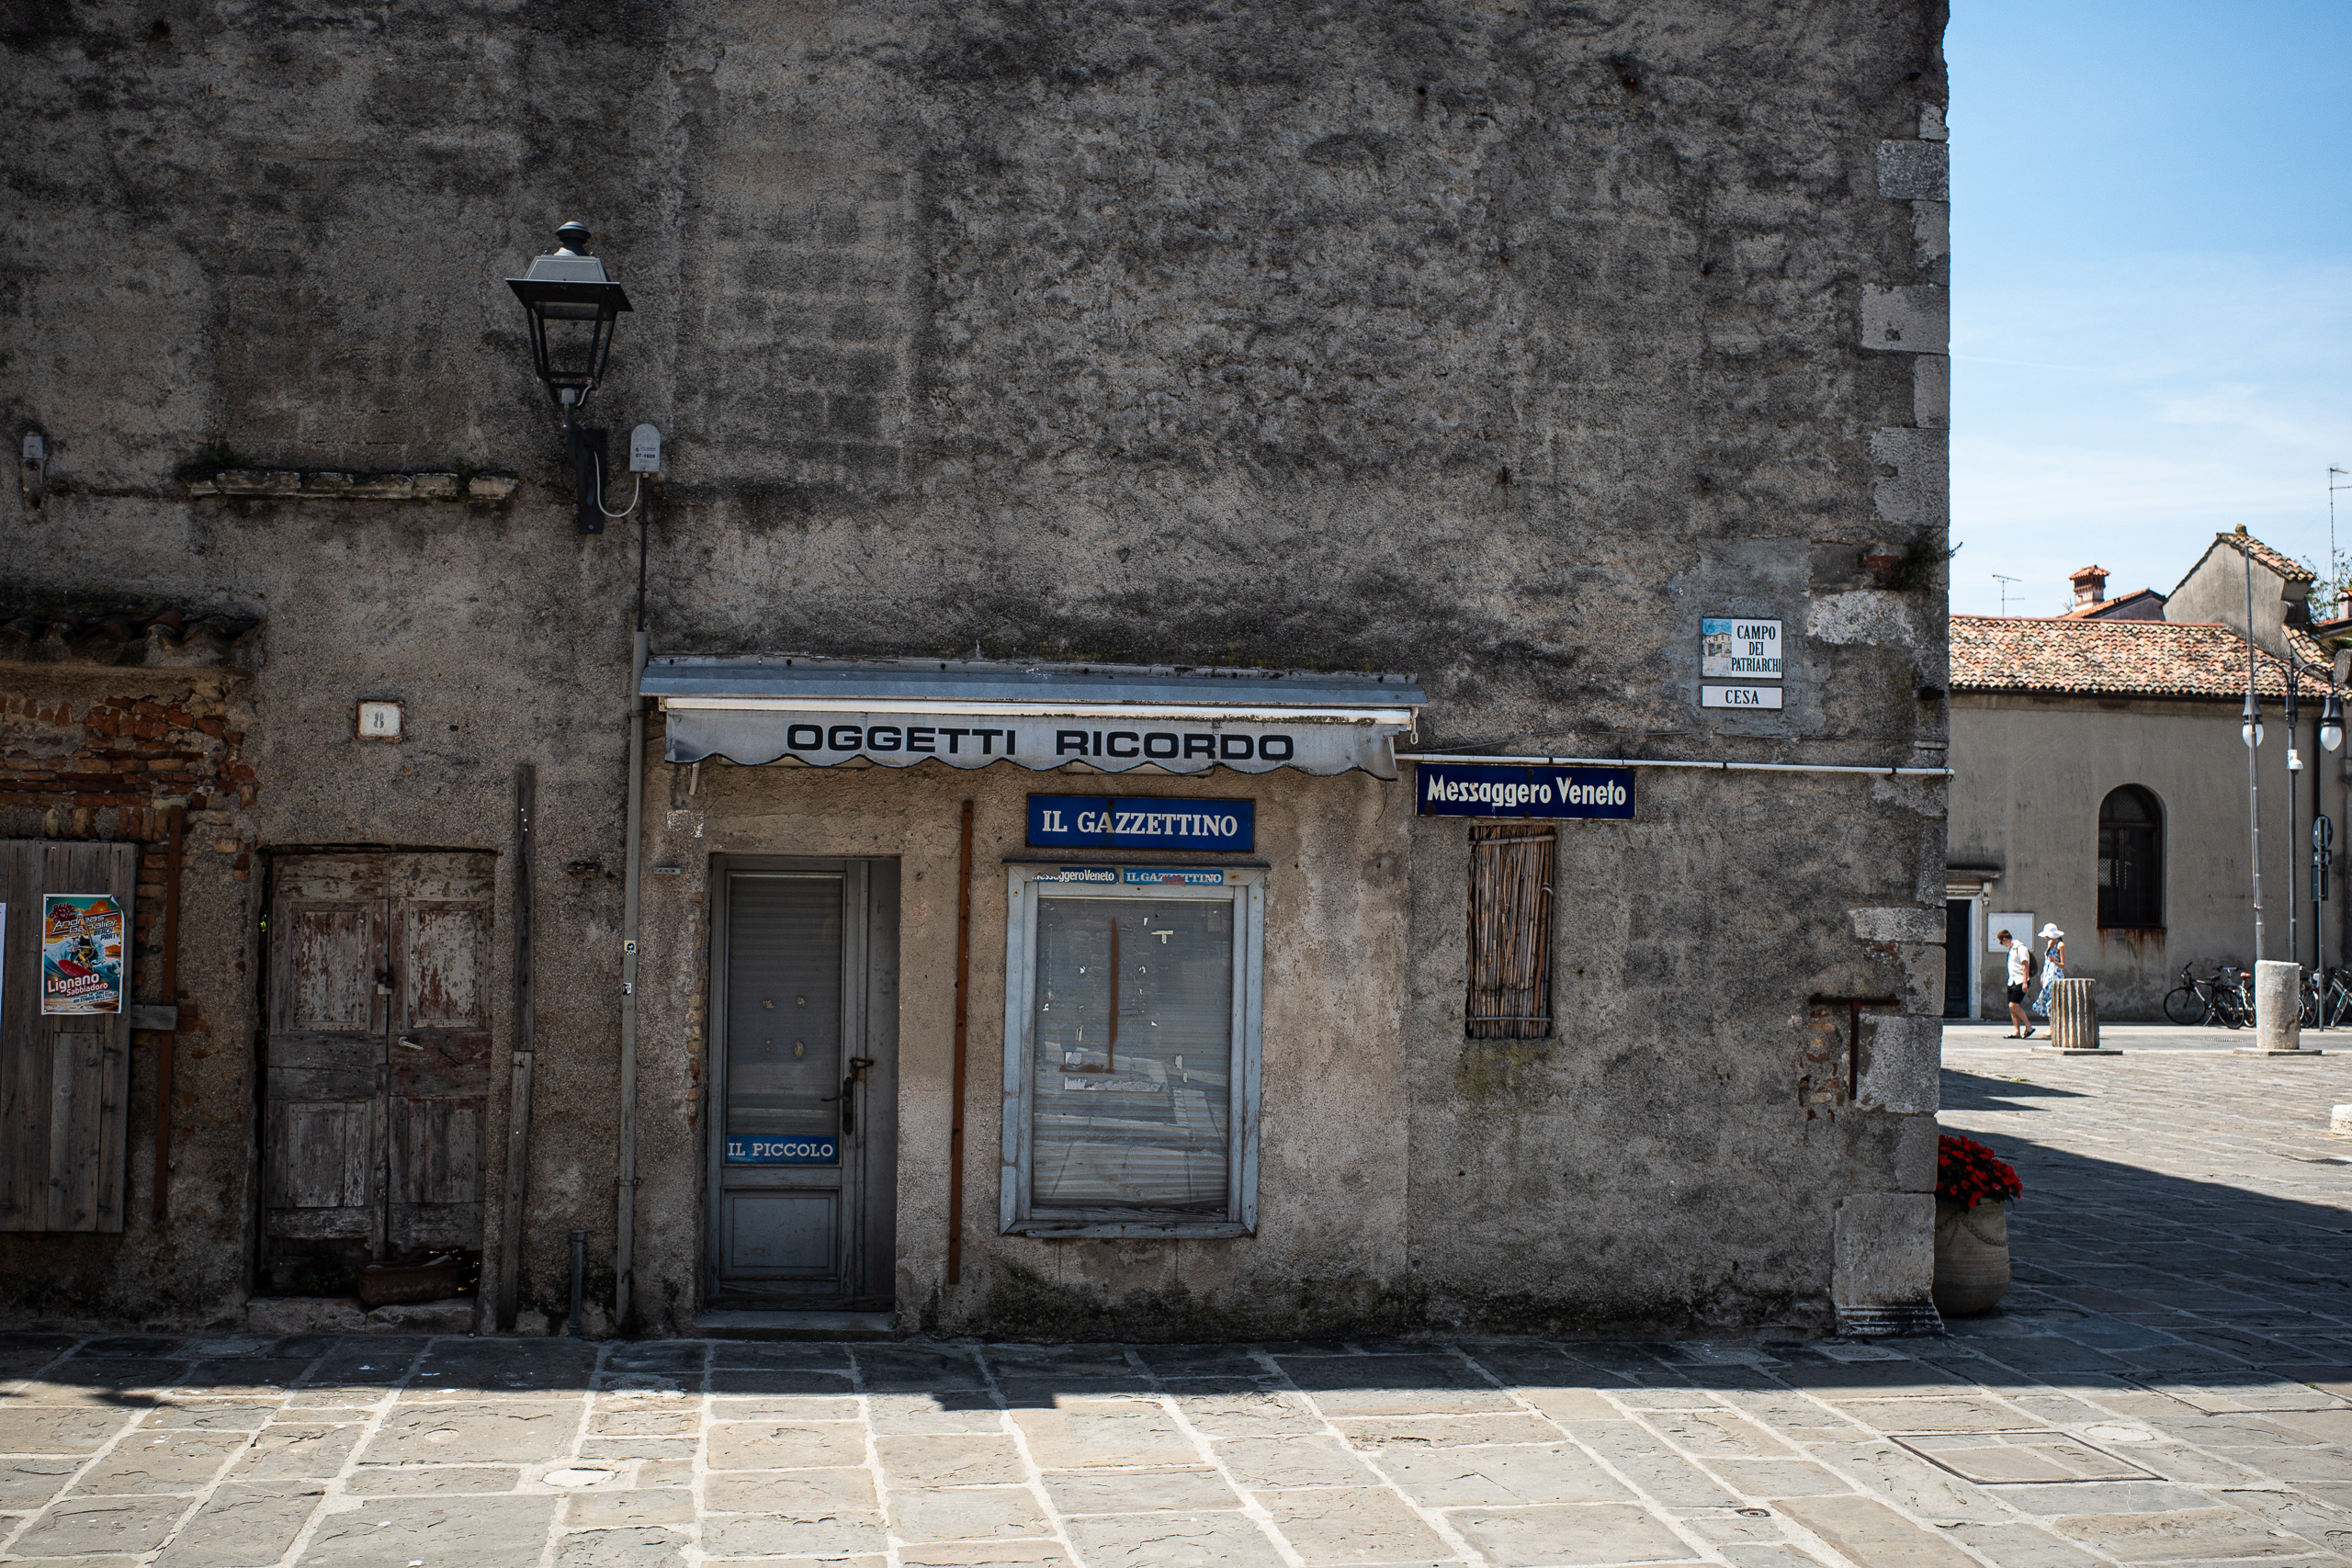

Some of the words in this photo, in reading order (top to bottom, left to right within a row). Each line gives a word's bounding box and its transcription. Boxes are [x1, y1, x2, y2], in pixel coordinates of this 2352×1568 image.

[1736, 625, 1776, 640] CAMPO
[1748, 641, 1764, 656] DEI
[1731, 657, 1781, 672] PATRIARCHI
[1724, 689, 1759, 705] CESA
[373, 711, 385, 728] 8
[786, 723, 1017, 756] OGGETTI
[1055, 728, 1295, 761] RICORDO
[1427, 773, 1552, 807] Messaggero
[1555, 776, 1627, 806] Veneto
[1042, 809, 1068, 832] IL
[1077, 811, 1238, 838] GAZZETTINO
[1125, 872, 1139, 882] IL
[93, 928, 113, 936] BEACH
[100, 932, 120, 941] PARTY
[48, 973, 100, 993] Lignano
[66, 982, 108, 997] Sabbiadoro
[728, 1142, 746, 1156] IL
[752, 1143, 834, 1157] PICCOLO
